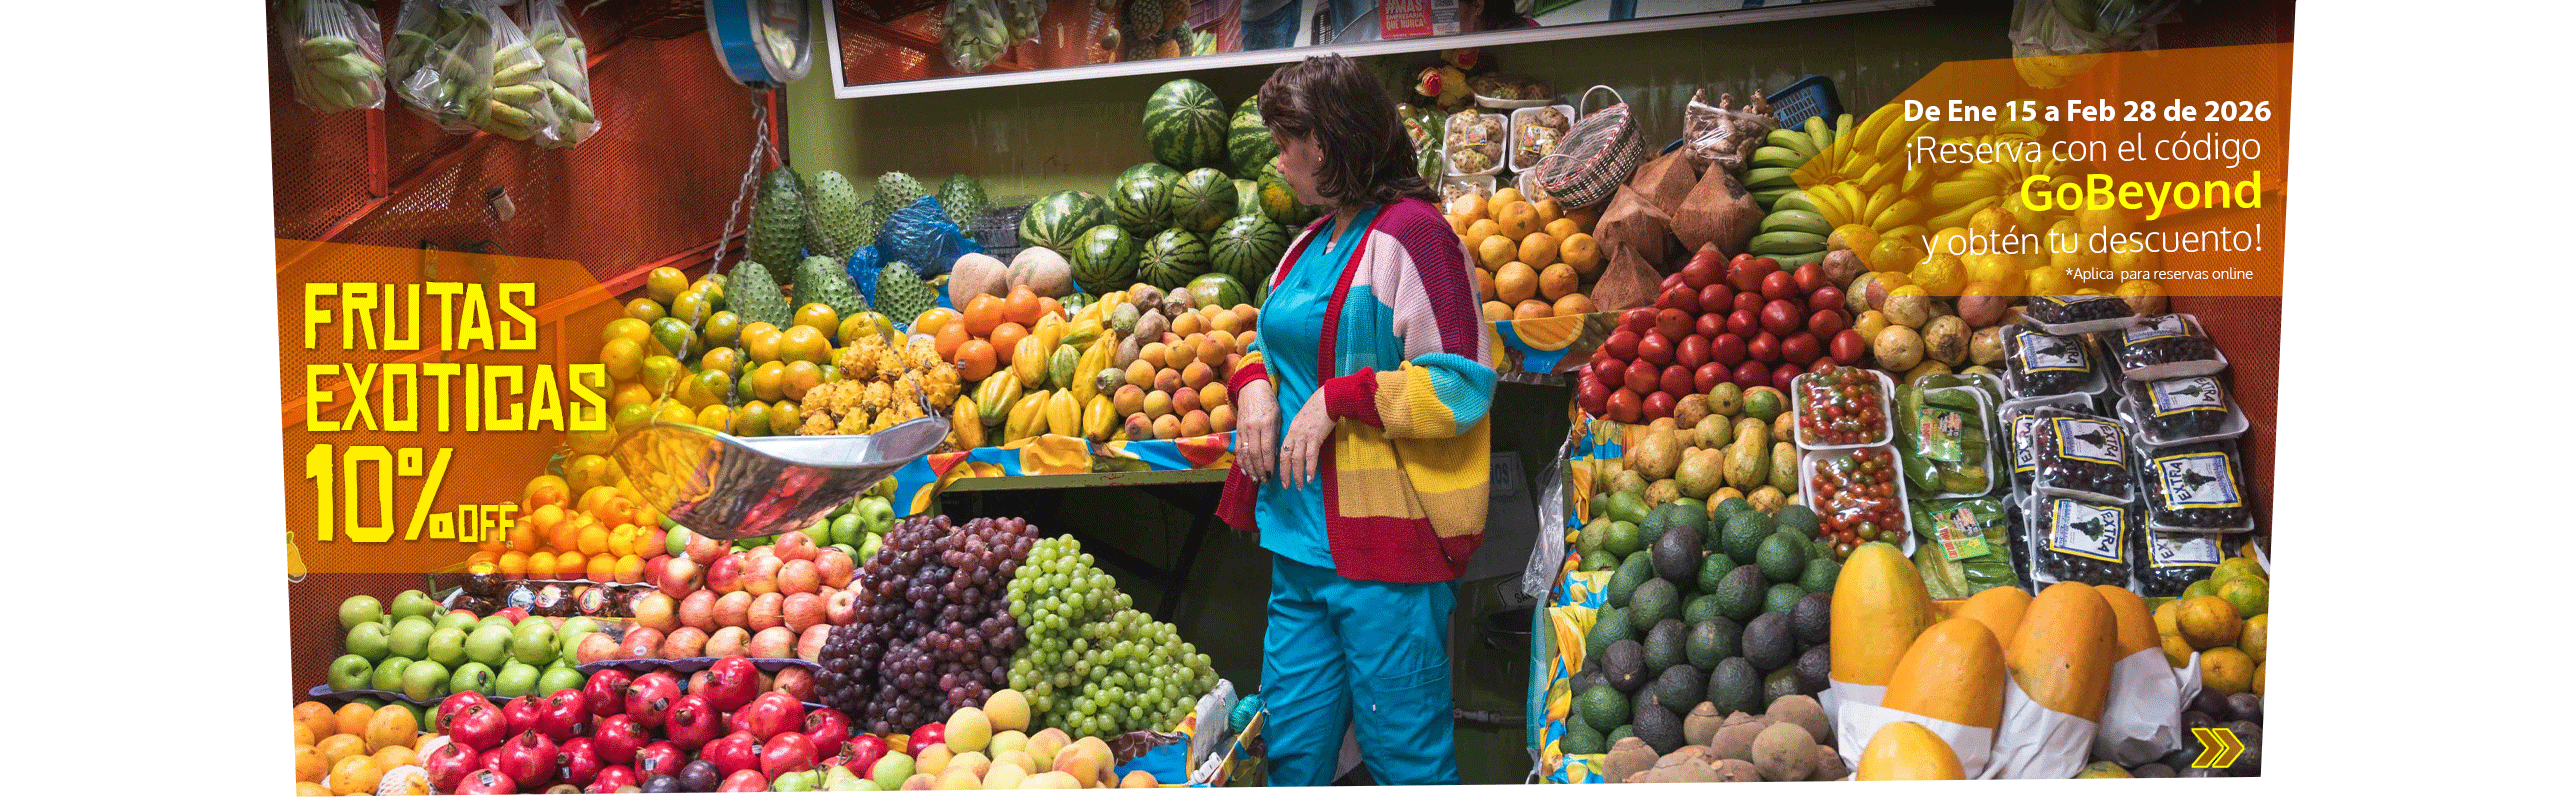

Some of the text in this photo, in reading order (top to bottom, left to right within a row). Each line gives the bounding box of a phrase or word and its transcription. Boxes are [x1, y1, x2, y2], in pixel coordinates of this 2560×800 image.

[1387, 19, 1424, 30] QUE NUNCA
[2193, 377, 2216, 402] EXTRA
[2018, 422, 2033, 463] EXRA
[2099, 425, 2118, 459] EXTRA
[2169, 461, 2193, 501] EXTRA
[2097, 511, 2116, 553] EXTRA
[2156, 532, 2175, 559] EXT
[1514, 591, 1532, 603] SA
